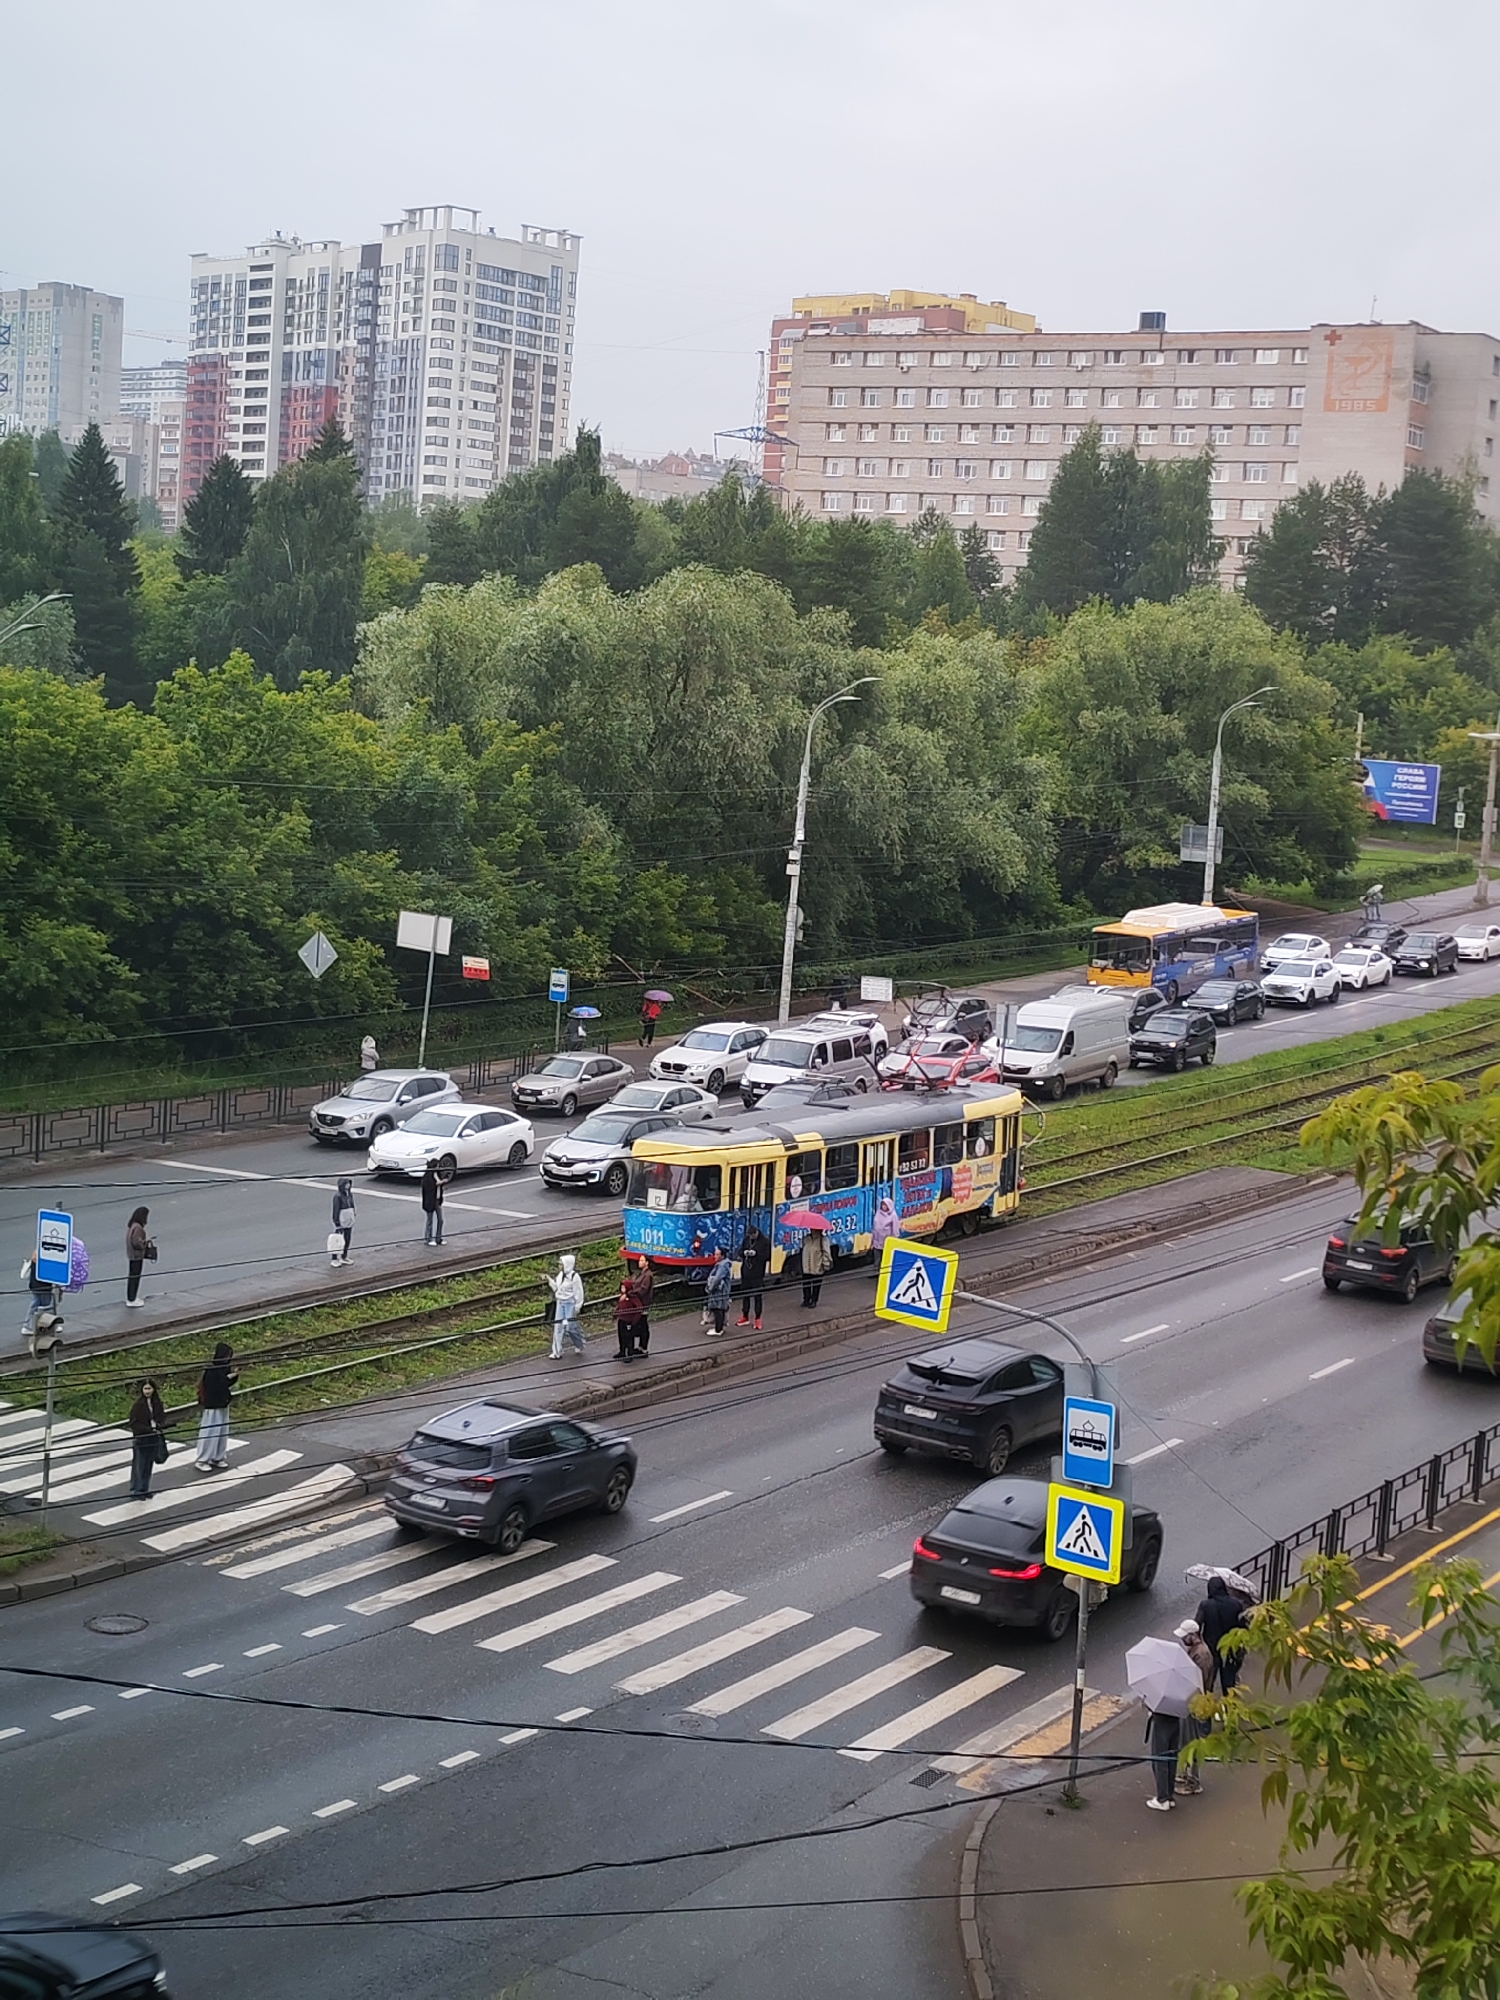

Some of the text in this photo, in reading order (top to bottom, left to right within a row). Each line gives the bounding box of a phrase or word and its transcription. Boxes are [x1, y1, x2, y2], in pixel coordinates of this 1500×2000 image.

[1335, 400, 1377, 411] 1985
[1397, 767, 1424, 775] СЛАВА
[640, 1227, 665, 1245] 1011
